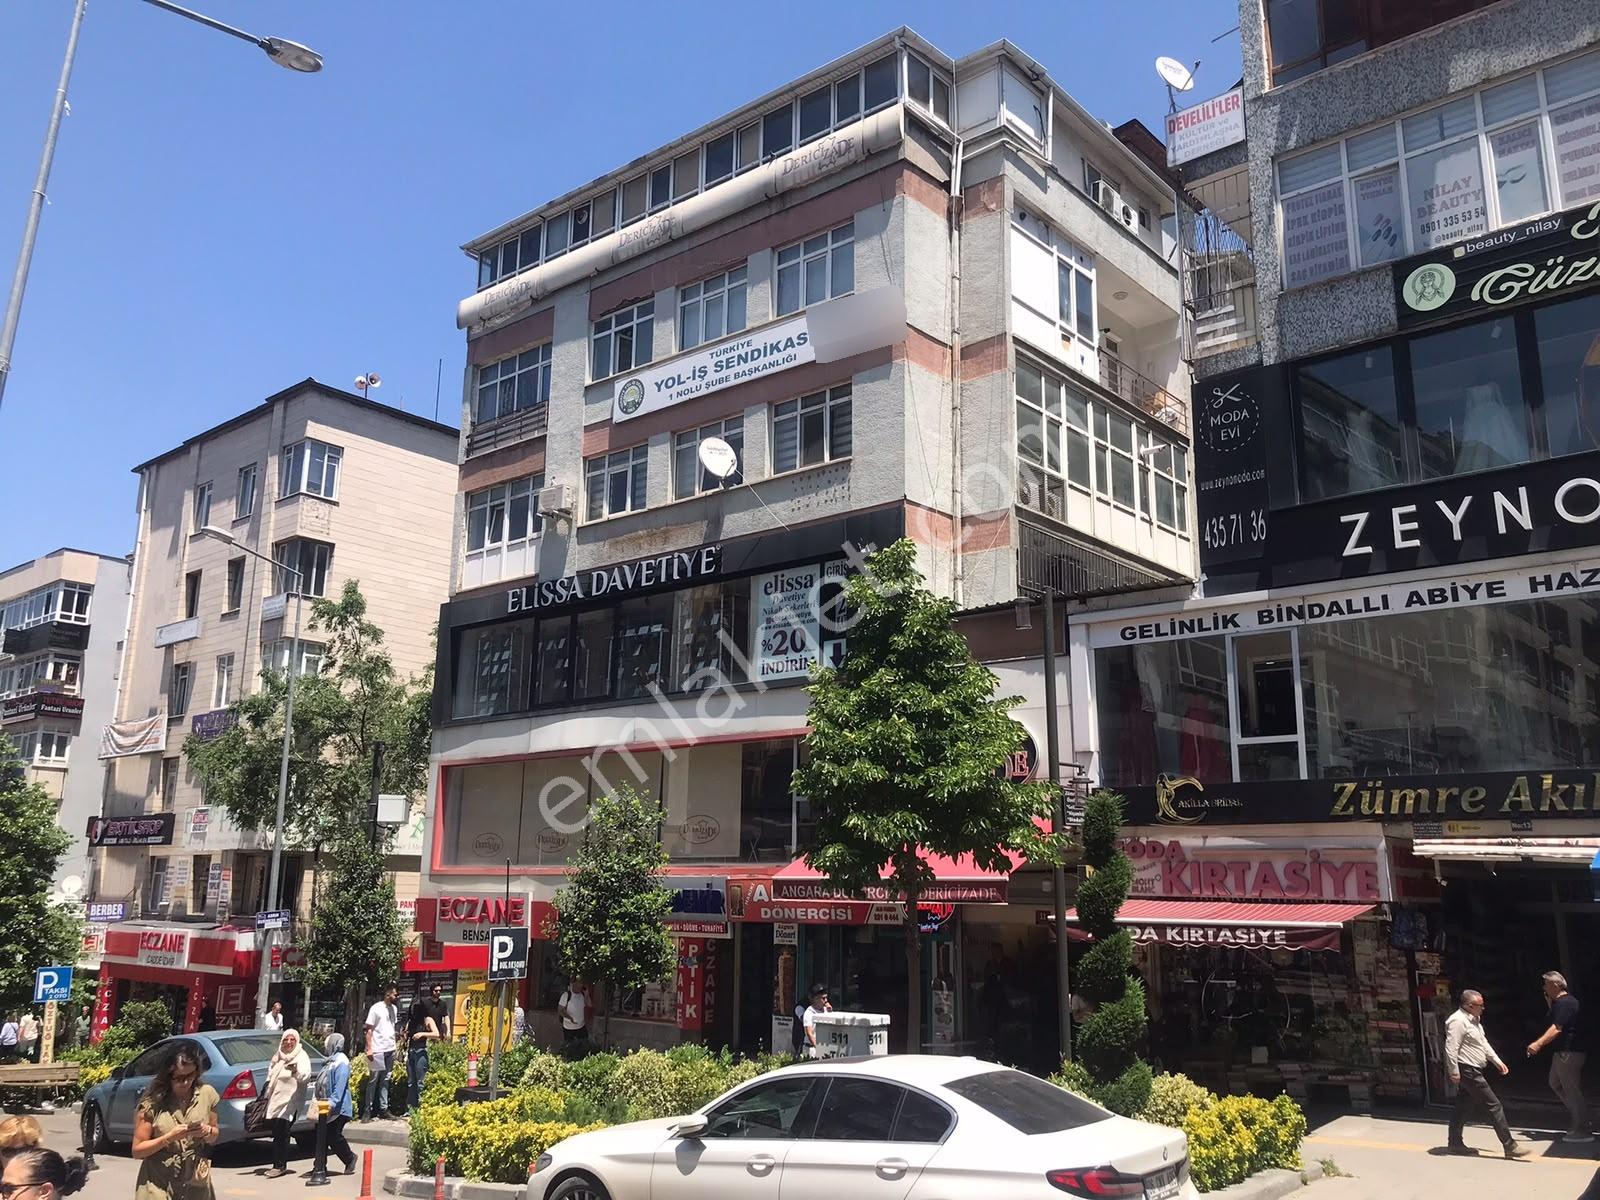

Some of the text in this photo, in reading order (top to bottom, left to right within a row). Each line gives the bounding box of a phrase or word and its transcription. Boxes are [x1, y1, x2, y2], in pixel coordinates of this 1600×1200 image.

[1168, 94, 1240, 134] DEVELİLİ'LER
[1424, 175, 1472, 200] NİLAY
[1417, 188, 1482, 218] BEAUTY
[1461, 210, 1473, 222] 53
[1467, 218, 1561, 252] beauty_nilay
[1471, 256, 1600, 304] Güz
[654, 331, 809, 393] YOL-İŞ SENDİKAS
[709, 339, 753, 360] TÜRKİYE
[668, 353, 797, 401] 1 NOLU ŞUBE BAŞKANLIĞI
[1211, 409, 1250, 427] MODA
[1221, 425, 1240, 441] EVİ
[1205, 509, 1266, 548] 435 71 36
[1340, 477, 1600, 556] ZEYNO
[592, 548, 717, 597] DAVETİYE
[764, 573, 814, 596] elissa
[1119, 612, 1241, 642] GELİNLİK
[1257, 593, 1390, 626] BİNDALLI
[1404, 579, 1506, 609] ABİYE
[1330, 780, 1487, 816] Zümre
[1161, 850, 1381, 898] KIRTASİYE
[781, 885, 830, 899] ANGARA
[919, 884, 997, 901] DERİCİZADE
[91, 903, 123, 916] BERBER
[439, 896, 525, 926] ECZANE
[761, 905, 852, 920] DÖNERCİSİ
[141, 931, 185, 953] ECZANE
[463, 929, 490, 941] BENSA
[1132, 926, 1287, 945] DA KIRTASİYE
[493, 935, 513, 972] P
[38, 971, 59, 999] P
[45, 986, 67, 995] TAKSİ
[677, 938, 685, 1022] CZANE
[686, 944, 698, 1018] PTİK
[705, 939, 717, 1024] CZANE
[216, 1015, 251, 1027] CZANE
[832, 1032, 848, 1045] 511
[869, 1034, 882, 1046] 511
